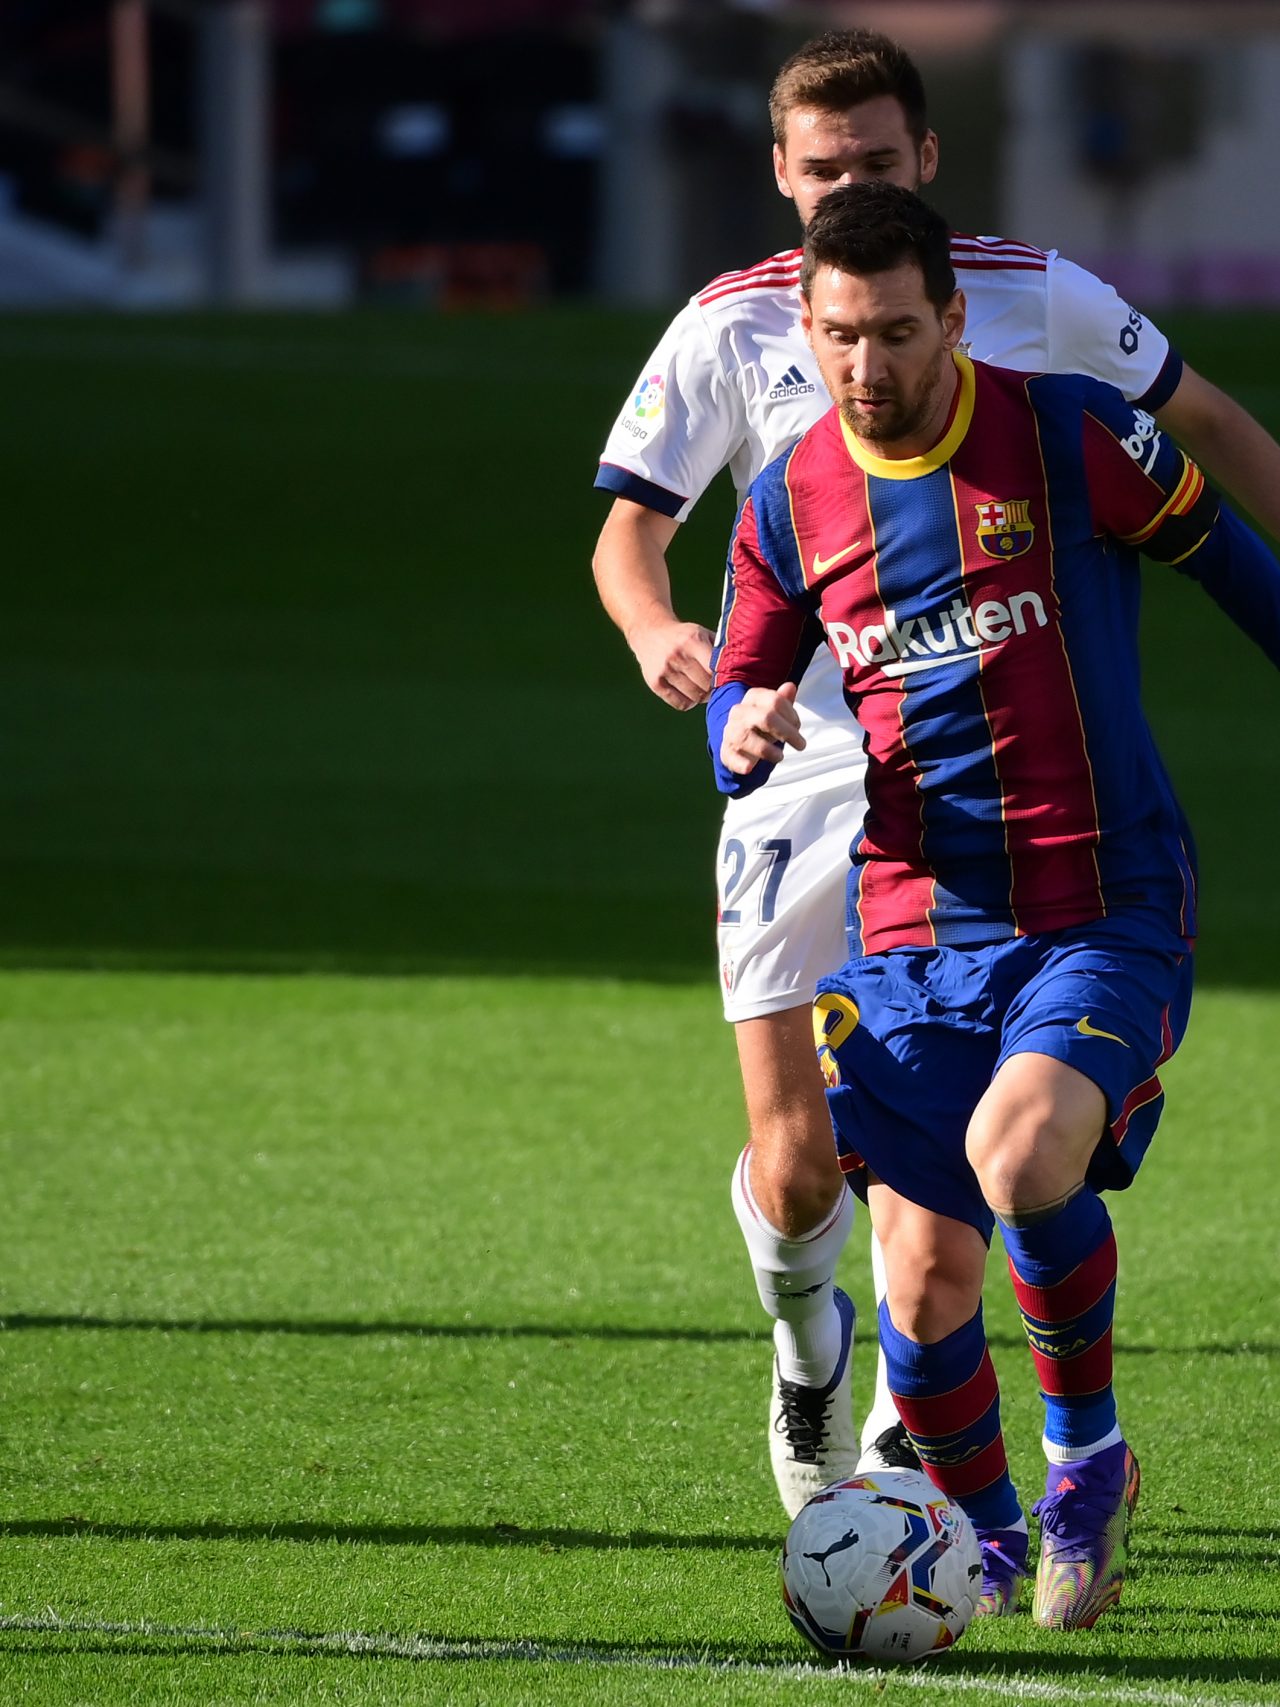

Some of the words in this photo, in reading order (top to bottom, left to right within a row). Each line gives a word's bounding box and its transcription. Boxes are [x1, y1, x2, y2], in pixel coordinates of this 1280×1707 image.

[769, 382, 815, 400] adidas
[1120, 409, 1156, 460] bek
[826, 590, 1048, 668] Rakuten
[719, 838, 793, 927] 27
